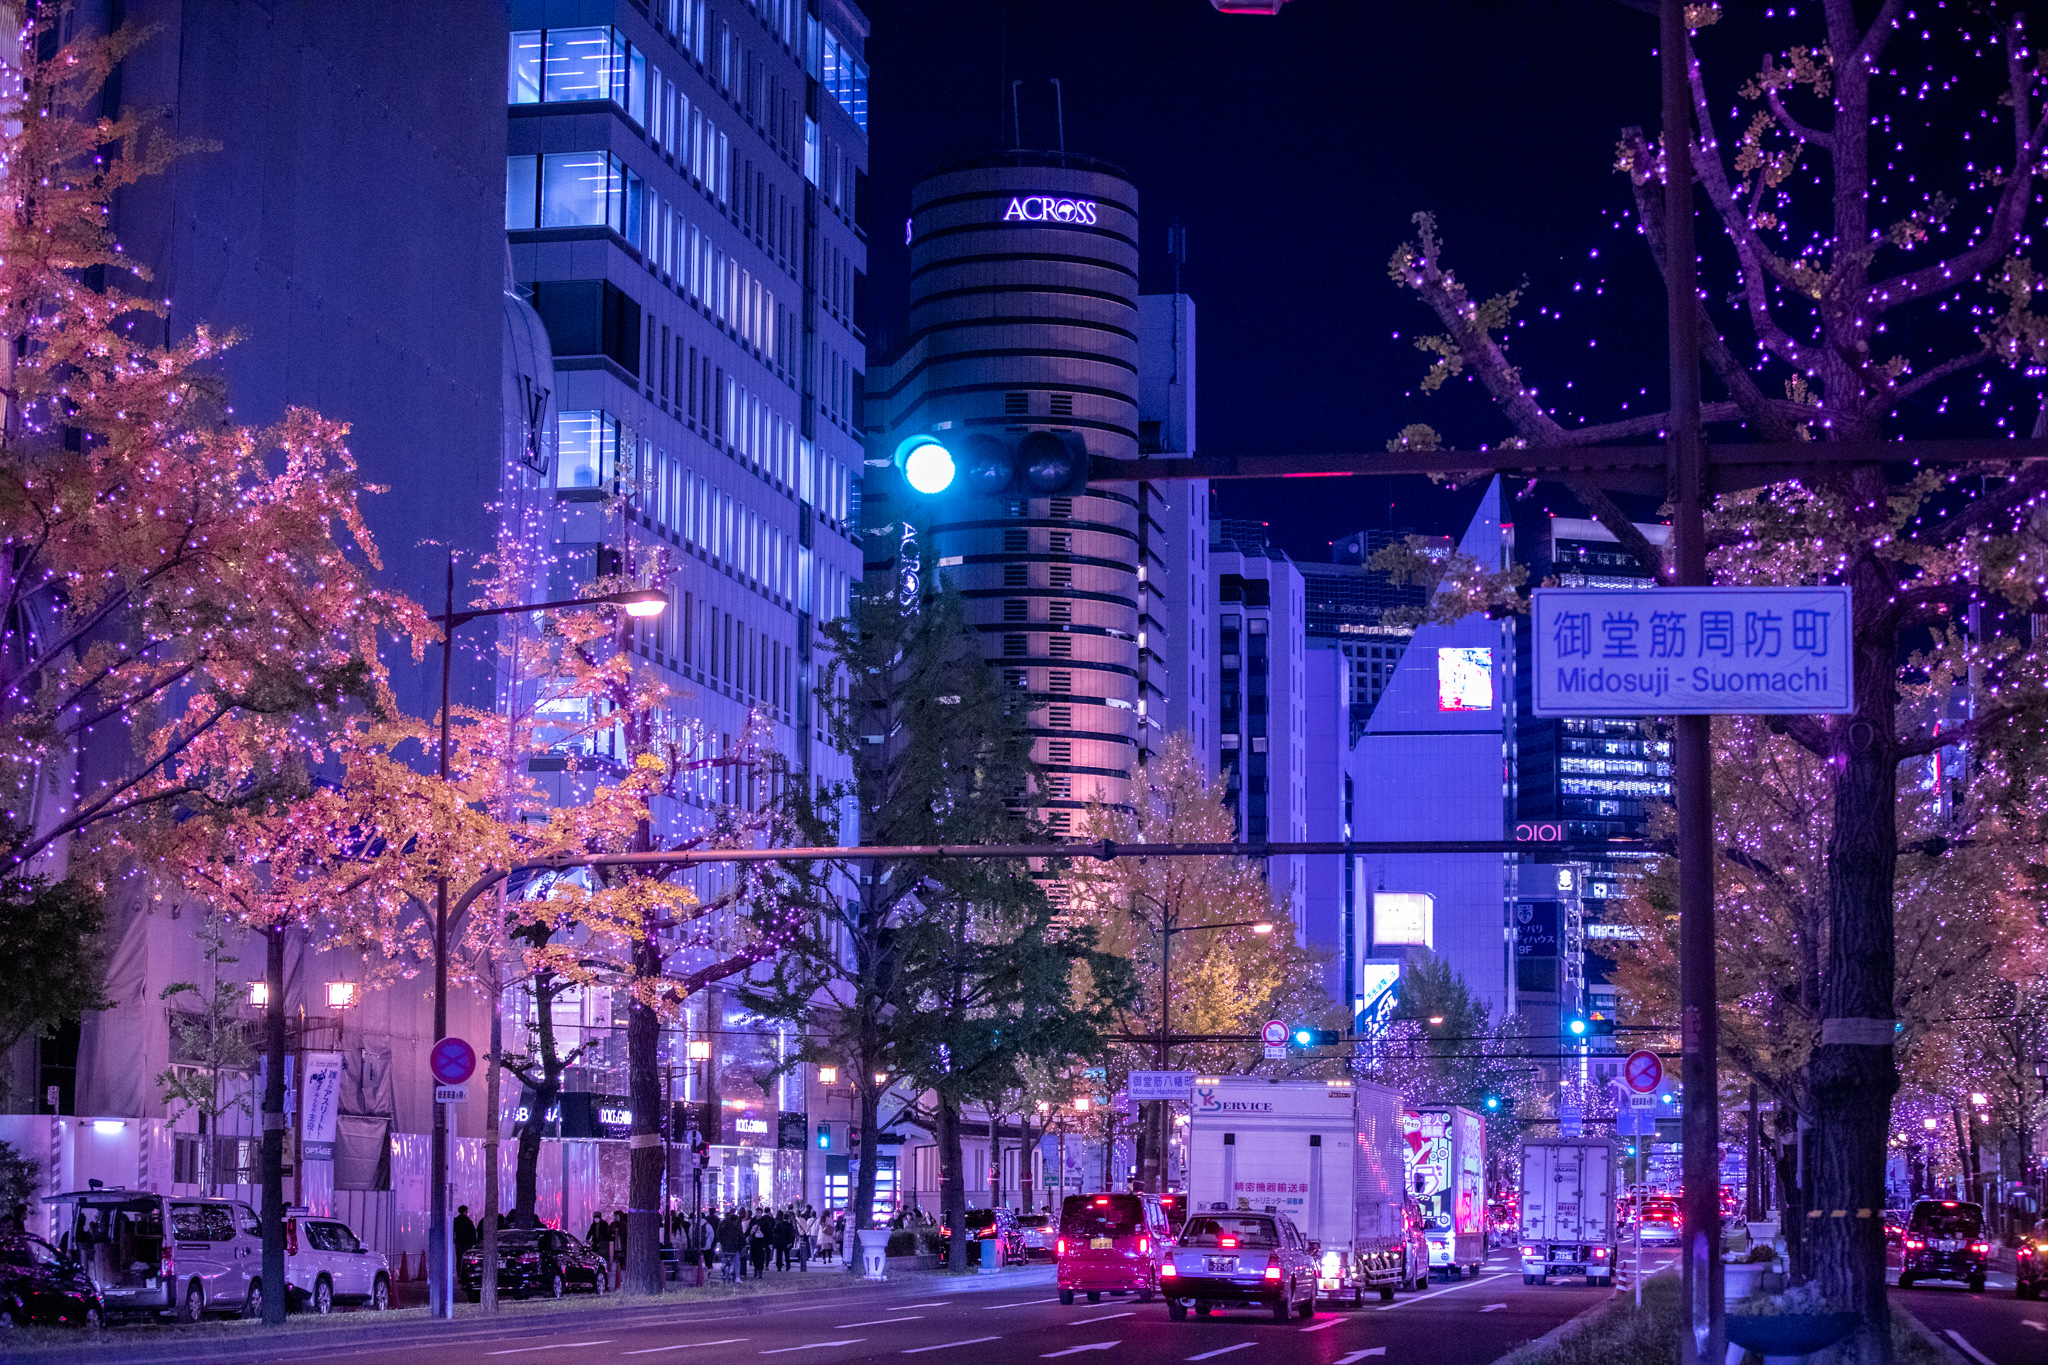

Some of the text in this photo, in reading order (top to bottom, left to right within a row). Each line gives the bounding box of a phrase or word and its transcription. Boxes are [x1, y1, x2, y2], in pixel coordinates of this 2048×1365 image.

[1002, 196, 1096, 225] ACROSS
[1554, 609, 1831, 660] 御堂筋周防町
[1132, 1088, 1190, 1096] Midosuji-Hachimanch
[304, 1146, 333, 1155] OPTAGE
[1234, 1182, 1309, 1193] 精密機器輸送車
